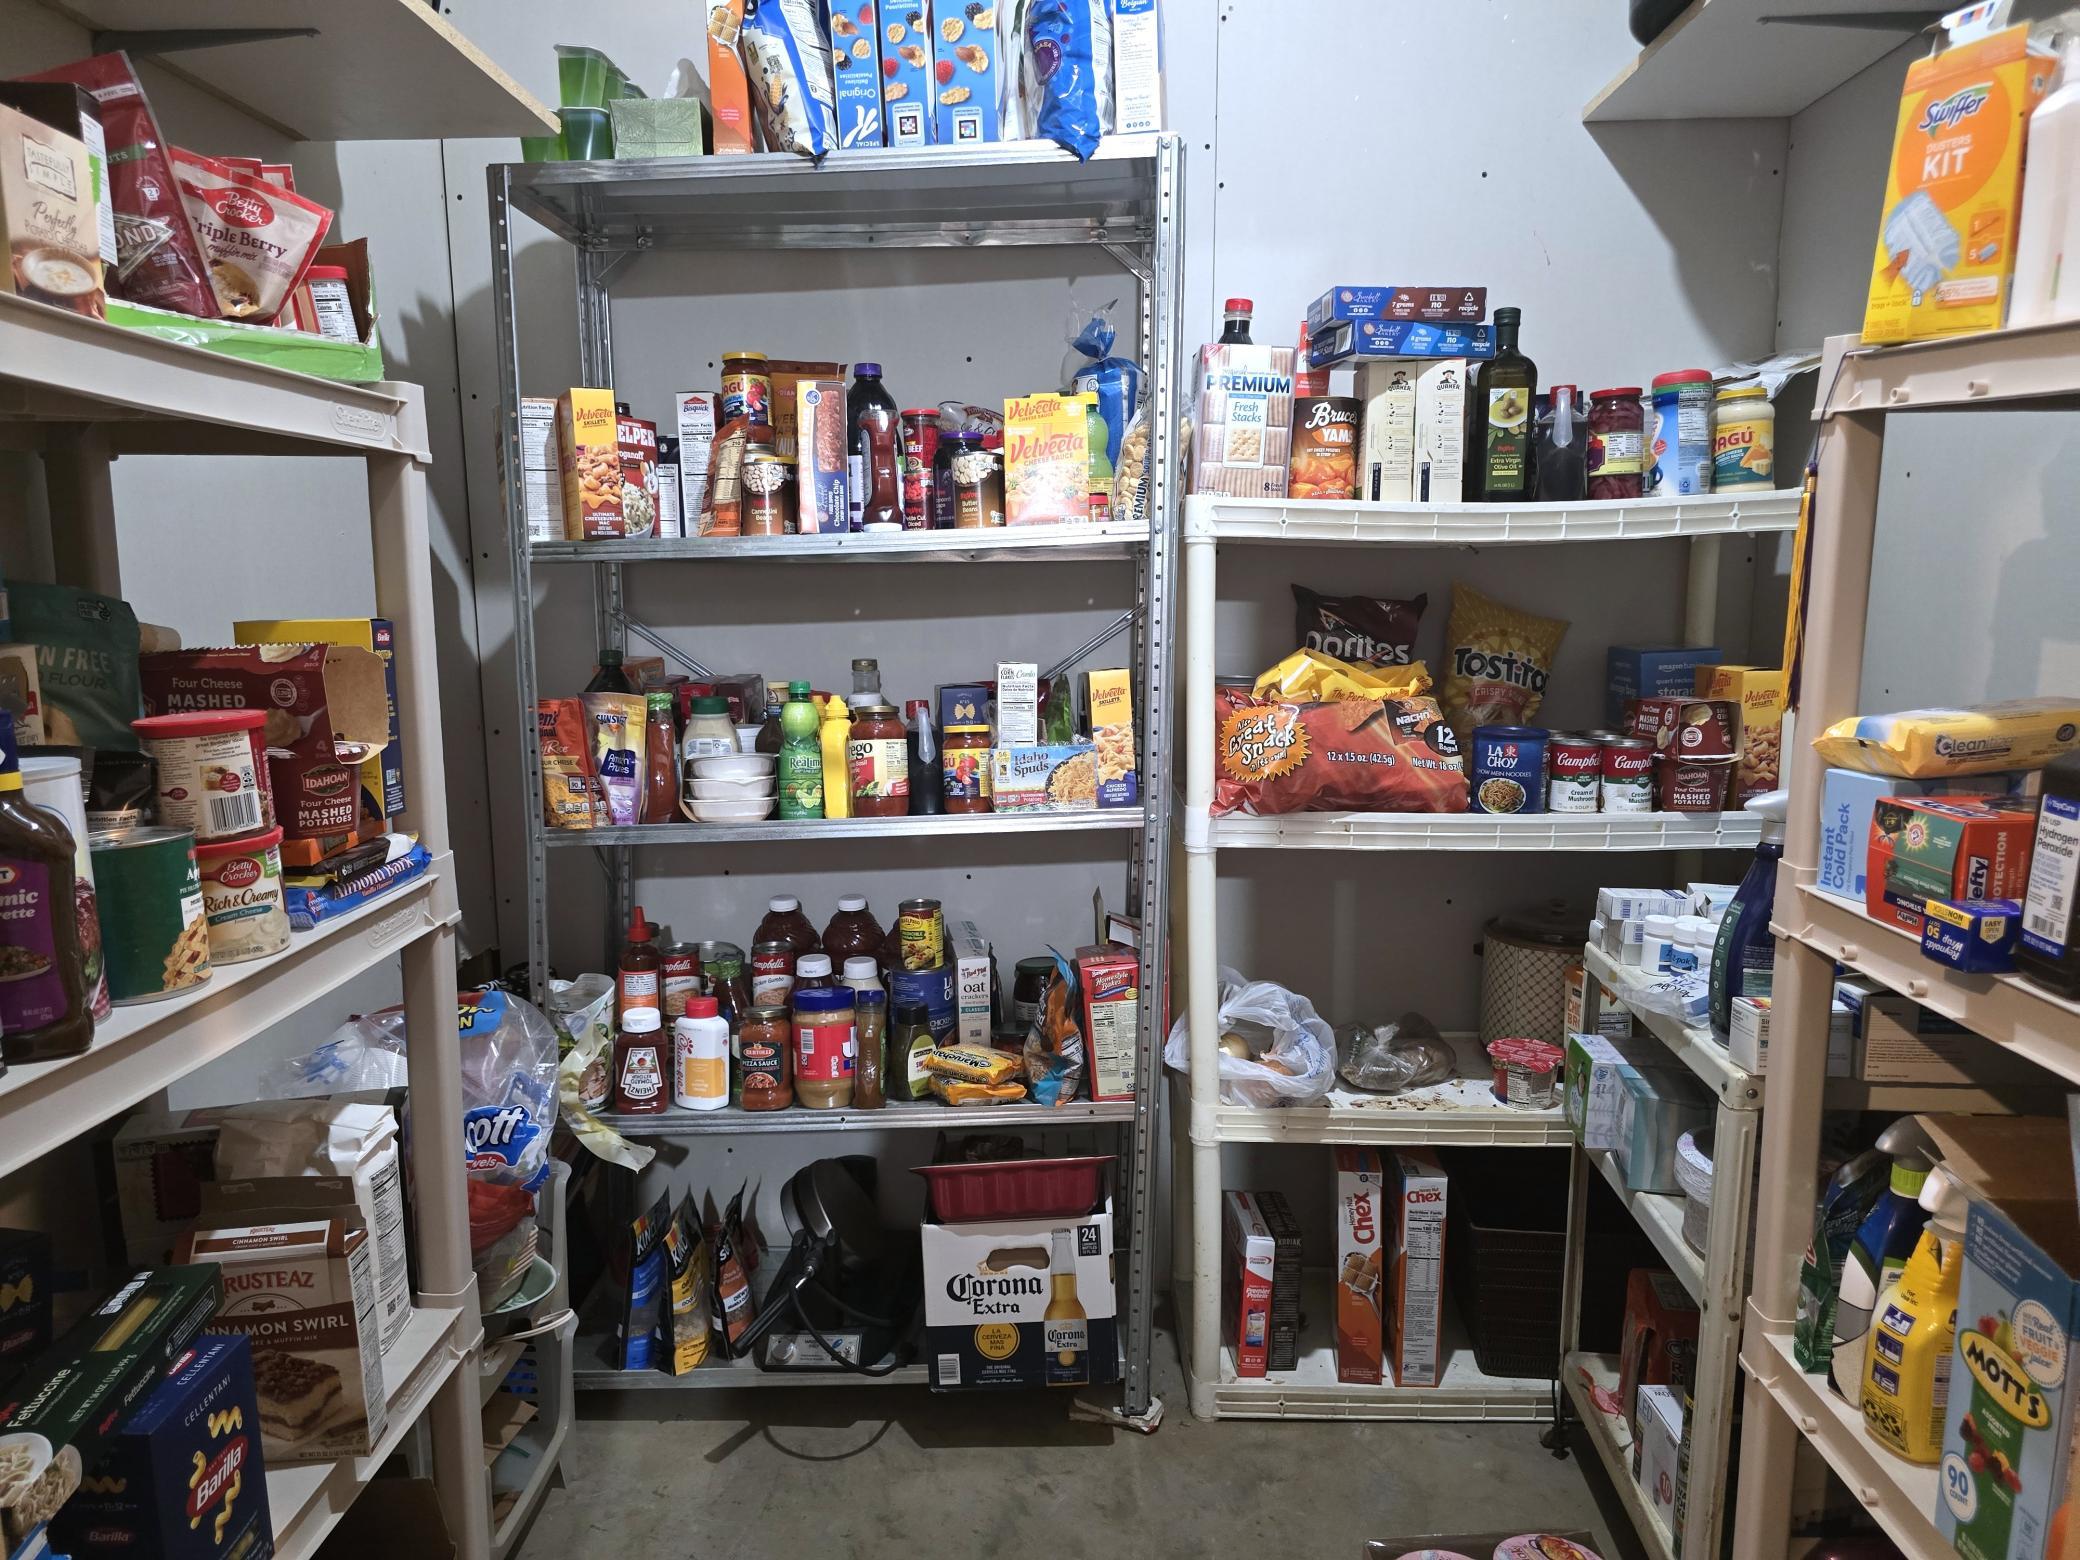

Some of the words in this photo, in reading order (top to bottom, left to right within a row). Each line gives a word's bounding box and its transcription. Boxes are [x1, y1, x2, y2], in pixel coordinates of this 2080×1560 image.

[840, 88, 875, 99] Original
[1919, 93, 1986, 131] Swiffer
[1922, 149, 1971, 181] KIT
[216, 200, 266, 226] Crocker
[225, 191, 264, 219] Betty
[32, 201, 78, 235] Perfectly
[207, 242, 241, 260] muffin
[241, 252, 258, 262] mix
[240, 231, 287, 258] Berry
[1206, 375, 1290, 393] PREMIUM
[576, 407, 613, 422] Velveeta
[683, 404, 709, 413] Bisquick
[1009, 399, 1061, 420] Velveeta
[1234, 402, 1258, 412] Fresh
[1305, 402, 1358, 429] Bruce's
[1232, 412, 1261, 422] Stacks
[617, 424, 655, 447] ELPER
[1322, 428, 1352, 442] YAMS
[618, 451, 645, 460] roganoff
[908, 445, 923, 453] BEEF
[1011, 434, 1083, 463] Velveeta
[1264, 482, 1270, 491] 8
[309, 651, 320, 661] 4
[1305, 631, 1409, 665] Doritos
[63, 648, 111, 673] FREE
[1658, 664, 1683, 672] amazon
[49, 673, 106, 689] FLOUR
[172, 678, 198, 688] Four
[201, 678, 243, 689] Cheese
[1092, 687, 1126, 701] Velveeta
[1475, 687, 1507, 696] CRISPY
[1744, 690, 1781, 703] Velveeta
[167, 694, 246, 708] MASHED
[1640, 714, 1659, 725] MASHED
[1229, 714, 1276, 757] Great
[1436, 725, 1456, 745] 12
[1241, 727, 1296, 765] Snack
[1488, 745, 1503, 757] LA
[789, 756, 821, 769] ReaLim
[1014, 752, 1049, 767] Idaho
[1327, 751, 1337, 761] 12
[1344, 752, 1356, 761] 1.5
[1369, 752, 1395, 765] (42.5g)
[1438, 761, 1446, 770] 18
[1487, 756, 1518, 768] CHOY
[1014, 761, 1049, 778] Spuds
[1677, 771, 1708, 780] IDAHOAN
[305, 771, 349, 789] IDAHOAN
[301, 798, 321, 808] Four
[323, 797, 352, 807] Cheese
[299, 804, 352, 820] MASHED
[299, 814, 352, 827] POTATOES
[1835, 802, 1850, 848] Pack
[2039, 825, 2079, 845] Hydrogen
[1820, 826, 1836, 887] Instant
[2037, 838, 2073, 858] Peroxide
[227, 861, 253, 872] Betty
[1832, 853, 1846, 889] Cold
[1992, 831, 2007, 901] OTECTION
[220, 869, 258, 882] Crocker
[335, 867, 384, 900] Almond
[386, 856, 415, 876] Bark
[1968, 859, 1988, 902] efty
[204, 894, 231, 915] Rich
[232, 895, 240, 906] &
[241, 888, 278, 906] Creamy
[1897, 897, 1921, 912] STRONG
[1926, 925, 1940, 939] 50
[1925, 939, 1960, 960] Reynolds
[1942, 934, 1963, 951] Wrap
[963, 982, 985, 993] oat
[1095, 972, 1128, 986] Homestyle
[1102, 979, 1121, 991] Bakes
[630, 1086, 653, 1095] HEINZ
[1407, 1190, 1442, 1204] Chex
[1348, 1208, 1356, 1226] Honey
[1353, 1193, 1375, 1244] Chex
[232, 1237, 268, 1245] CINNAMON
[269, 1235, 289, 1243] SWIRL
[1082, 1228, 1096, 1242] 24
[671, 1239, 688, 1267] KIND
[946, 1273, 1043, 1305] Corona
[973, 1298, 1020, 1315] Extra
[293, 1314, 349, 1333] SWIRL
[1048, 1329, 1085, 1344] Corona
[2022, 1325, 2053, 1346] FRUIT
[2019, 1334, 2059, 1362] VEGGIE
[177, 1342, 225, 1387] CELLENTANI
[1966, 1339, 2040, 1420] MOTT'S
[6, 1368, 71, 1428] Fettuccine
[185, 1375, 231, 1427] CELLENTANI
[1638, 1391, 1653, 1424] LED
[196, 1445, 243, 1510] Barilla
[1948, 1464, 1968, 1496] 90
[1949, 1488, 1969, 1506] COUNT
[88, 1531, 129, 1542] Barilla
